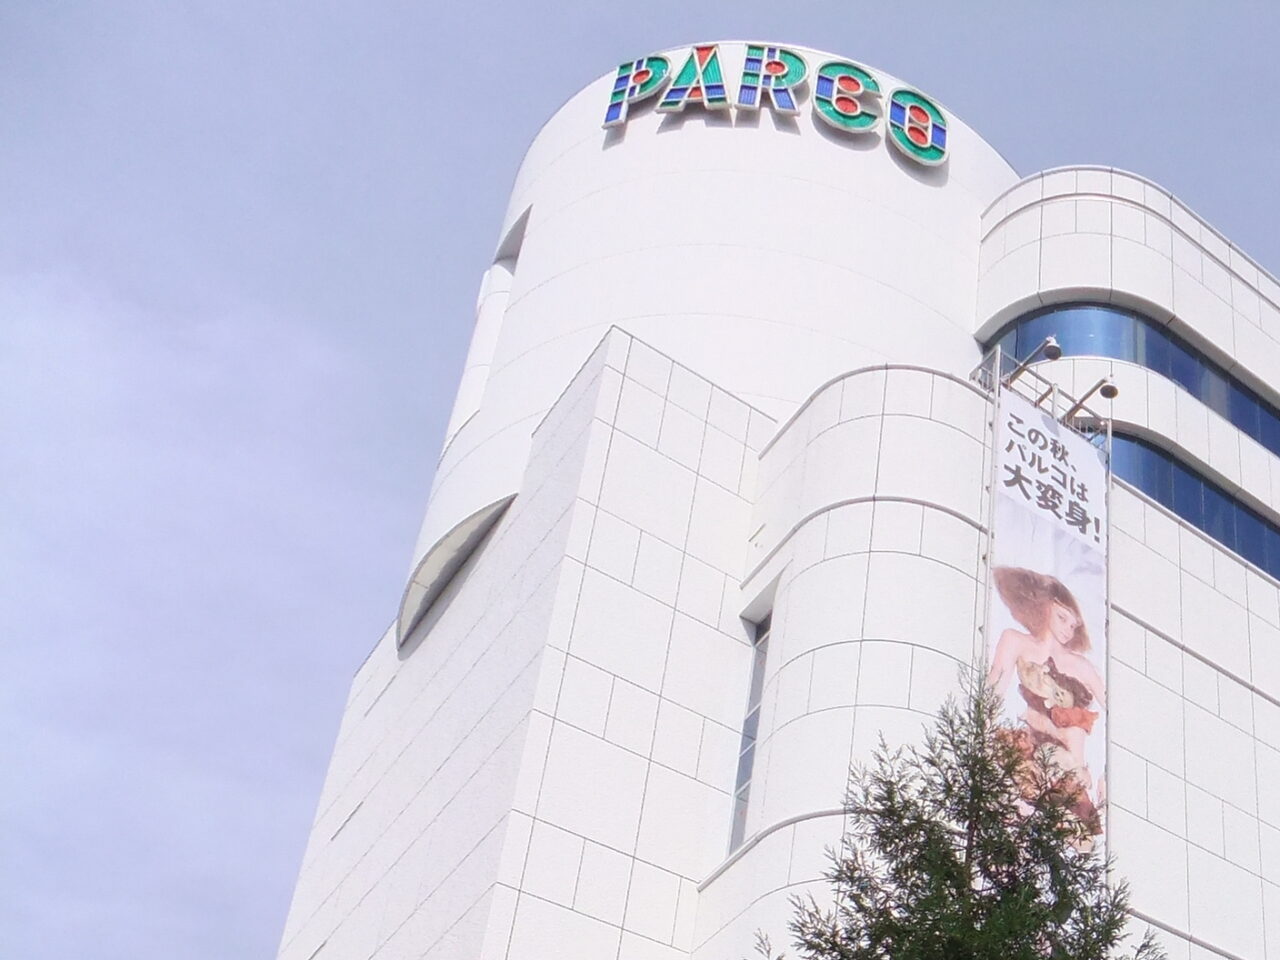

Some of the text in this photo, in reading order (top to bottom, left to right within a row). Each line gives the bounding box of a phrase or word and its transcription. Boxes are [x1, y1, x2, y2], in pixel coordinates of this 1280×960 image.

[601, 42, 950, 167] PARCO
[1005, 439, 1089, 503] パルコは
[1007, 412, 1077, 472] この秋、
